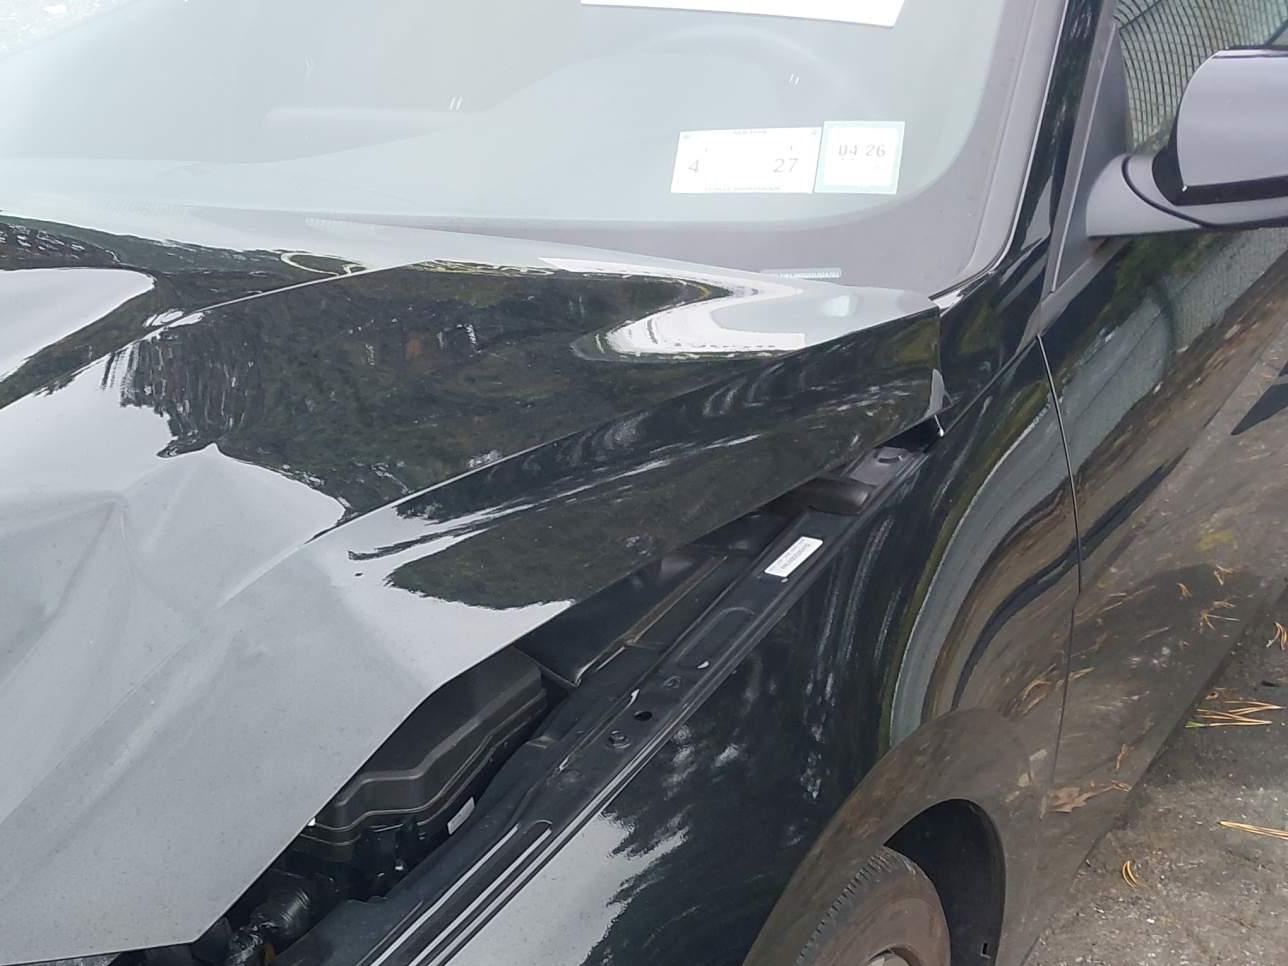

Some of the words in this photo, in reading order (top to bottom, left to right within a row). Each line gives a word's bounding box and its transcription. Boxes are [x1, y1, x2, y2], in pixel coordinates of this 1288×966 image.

[864, 143, 886, 158] 26
[687, 159, 700, 174] 4
[773, 157, 800, 174] 27
